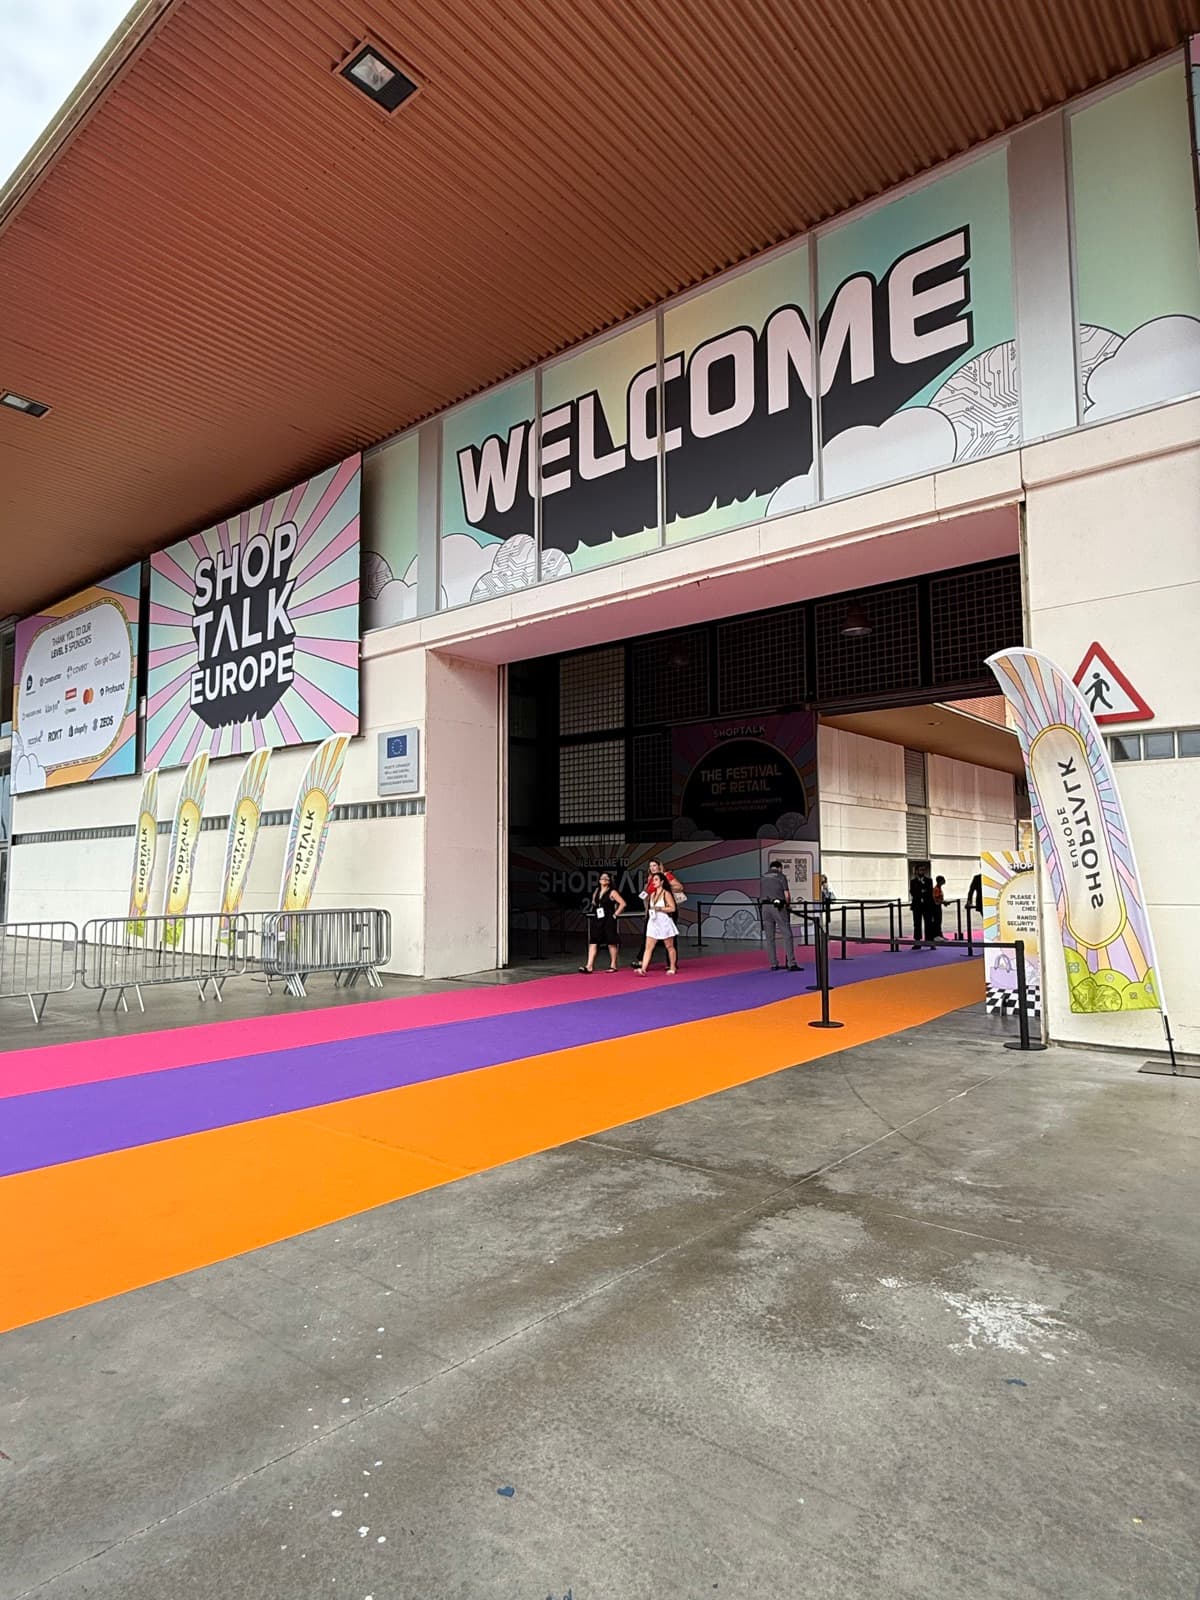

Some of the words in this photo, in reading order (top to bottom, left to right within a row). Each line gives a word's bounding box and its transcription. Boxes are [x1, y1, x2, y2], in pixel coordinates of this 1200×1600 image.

[457, 226, 972, 525] WELCOME
[193, 522, 299, 607] SHOP
[193, 580, 297, 662] TALK
[190, 644, 295, 706] EUROPE
[712, 725, 766, 738] SHOPTALK
[699, 769, 723, 783] THE
[726, 762, 783, 781] FESTIVAL
[711, 782, 726, 796] OF
[729, 778, 771, 793] RETAIL
[138, 827, 148, 893] SHOPTALK
[172, 817, 190, 895] SHOPTALK
[230, 815, 247, 888] PTALK
[538, 870, 644, 894] SHOPTAL
[576, 856, 617, 868] WELCOME
[618, 857, 630, 867] TO
